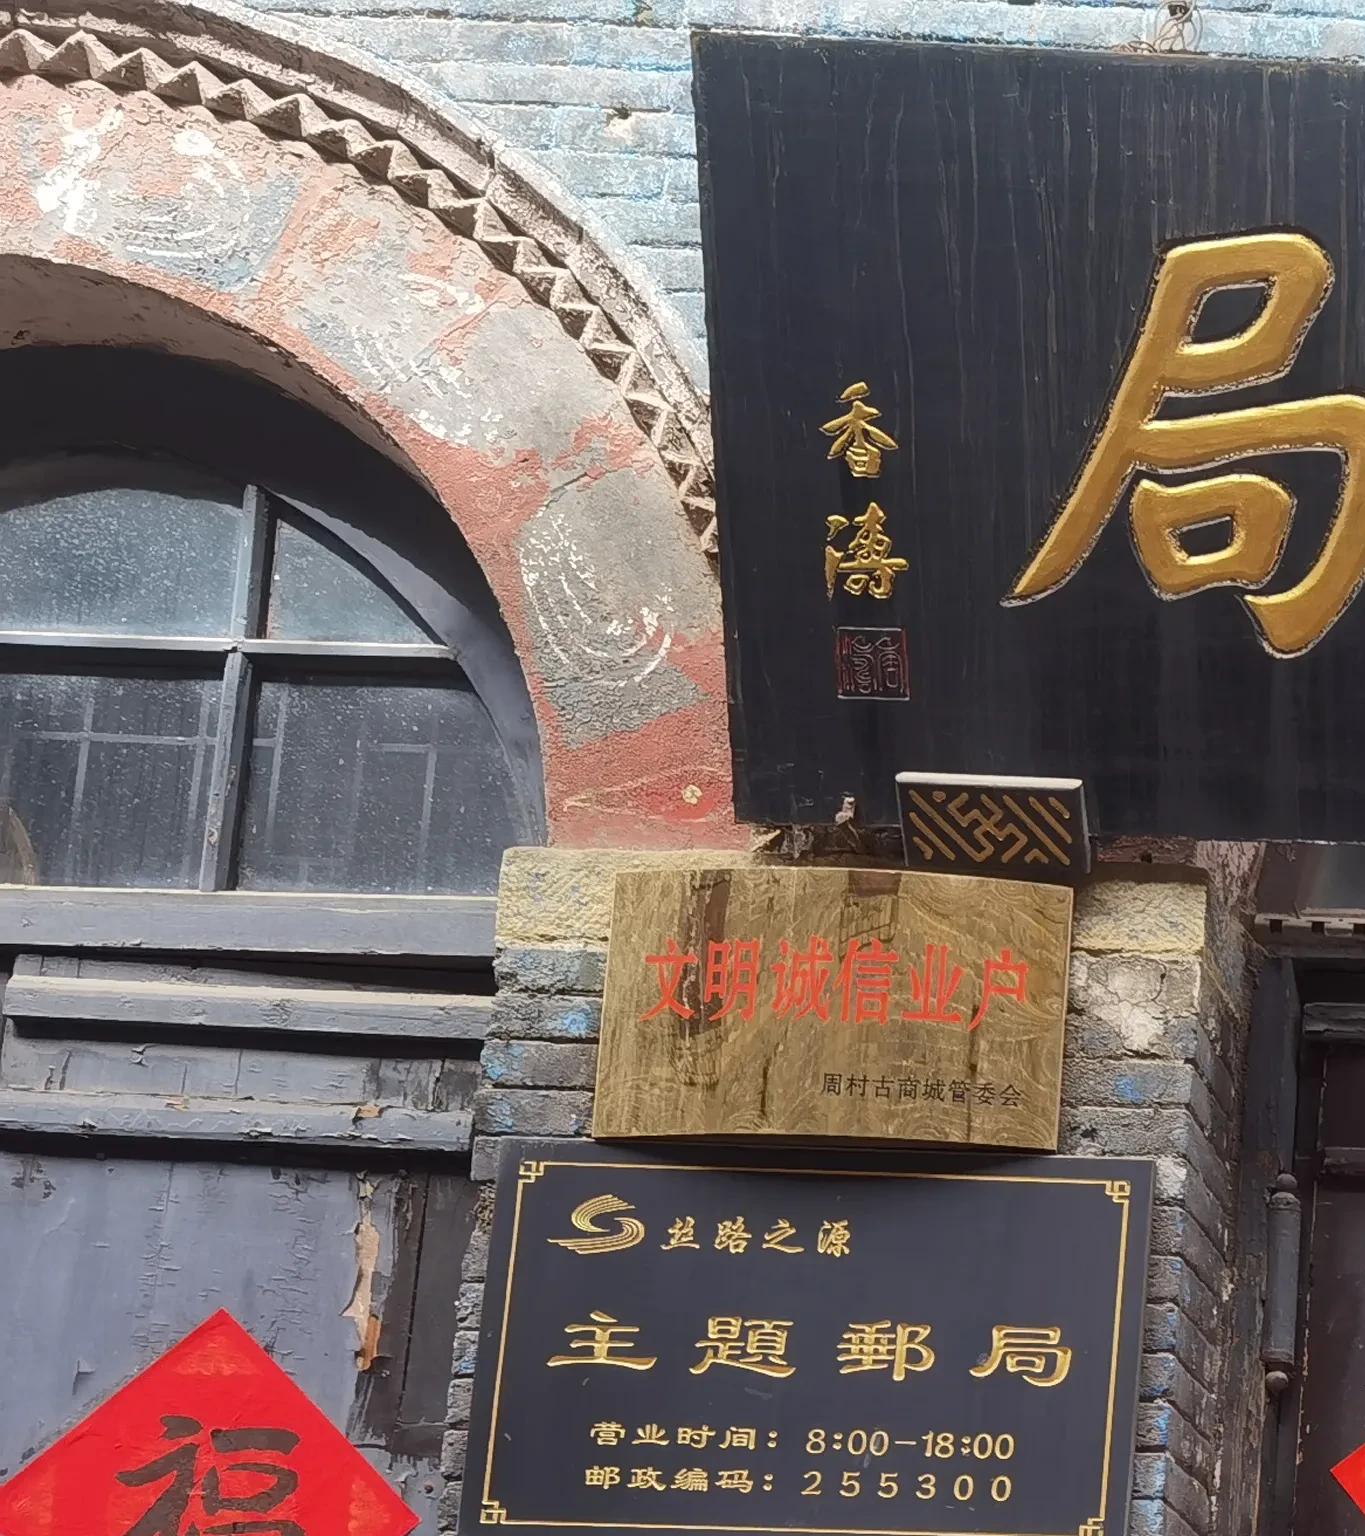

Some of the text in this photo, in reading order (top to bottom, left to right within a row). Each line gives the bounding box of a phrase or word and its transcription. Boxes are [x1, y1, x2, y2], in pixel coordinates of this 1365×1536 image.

[639, 936, 1030, 1032] 文明诚信业户
[820, 1072, 1022, 1107] 周村古商城管委会
[660, 1217, 851, 1259] 丝路之源
[546, 1310, 1072, 1387] 主題郵局
